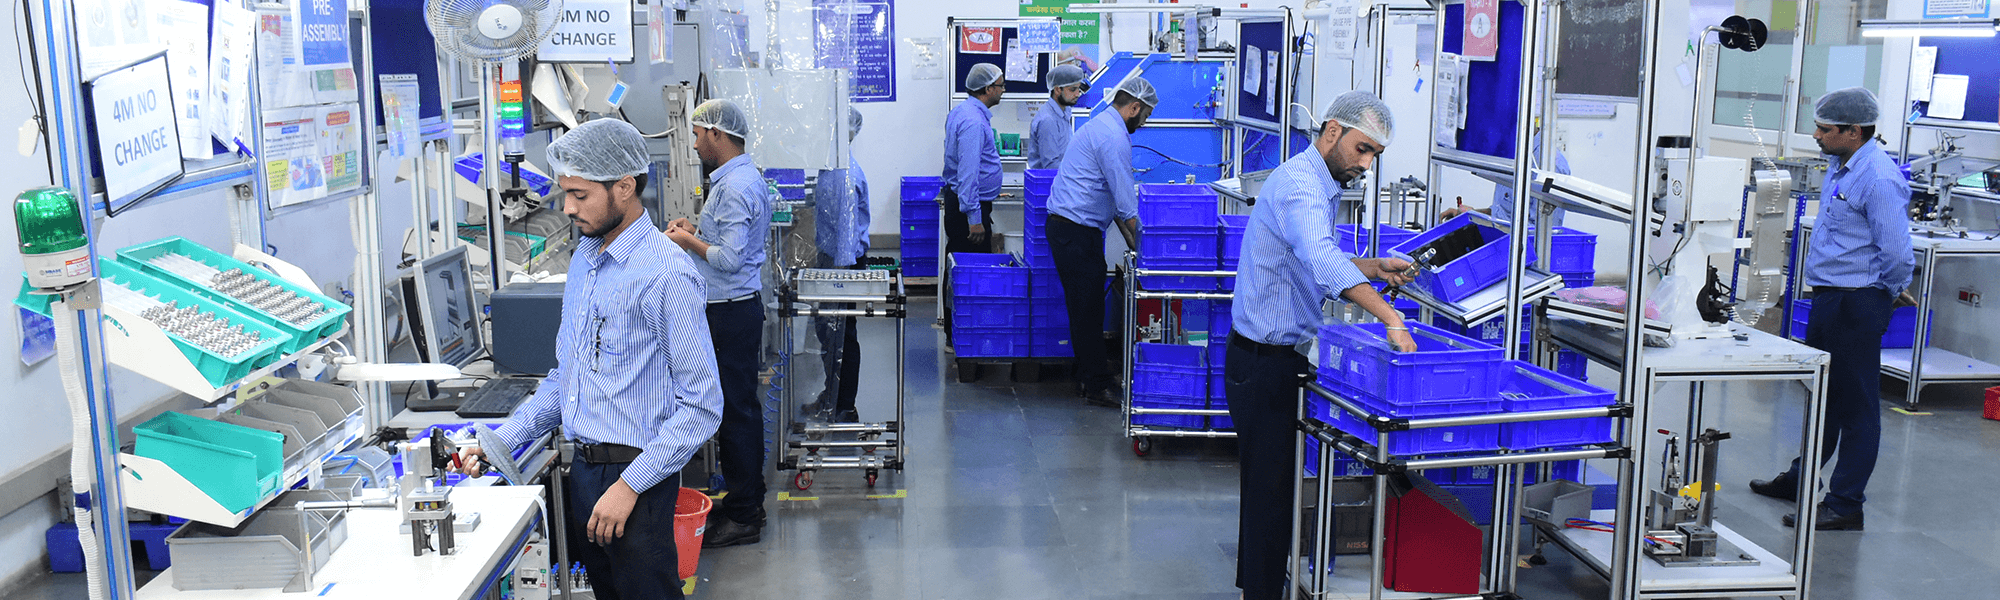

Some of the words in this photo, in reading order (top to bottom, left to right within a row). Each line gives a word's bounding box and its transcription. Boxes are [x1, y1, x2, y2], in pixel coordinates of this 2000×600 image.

[312, 0, 334, 15] PRE-
[586, 10, 610, 23] NO
[303, 24, 346, 42] ASSEMBLY
[1476, 17, 1484, 34] A
[551, 33, 616, 46] CHANGE
[977, 34, 985, 42] A
[114, 96, 135, 123] 4M
[137, 89, 158, 115] NO
[115, 126, 168, 167] CHANGE
